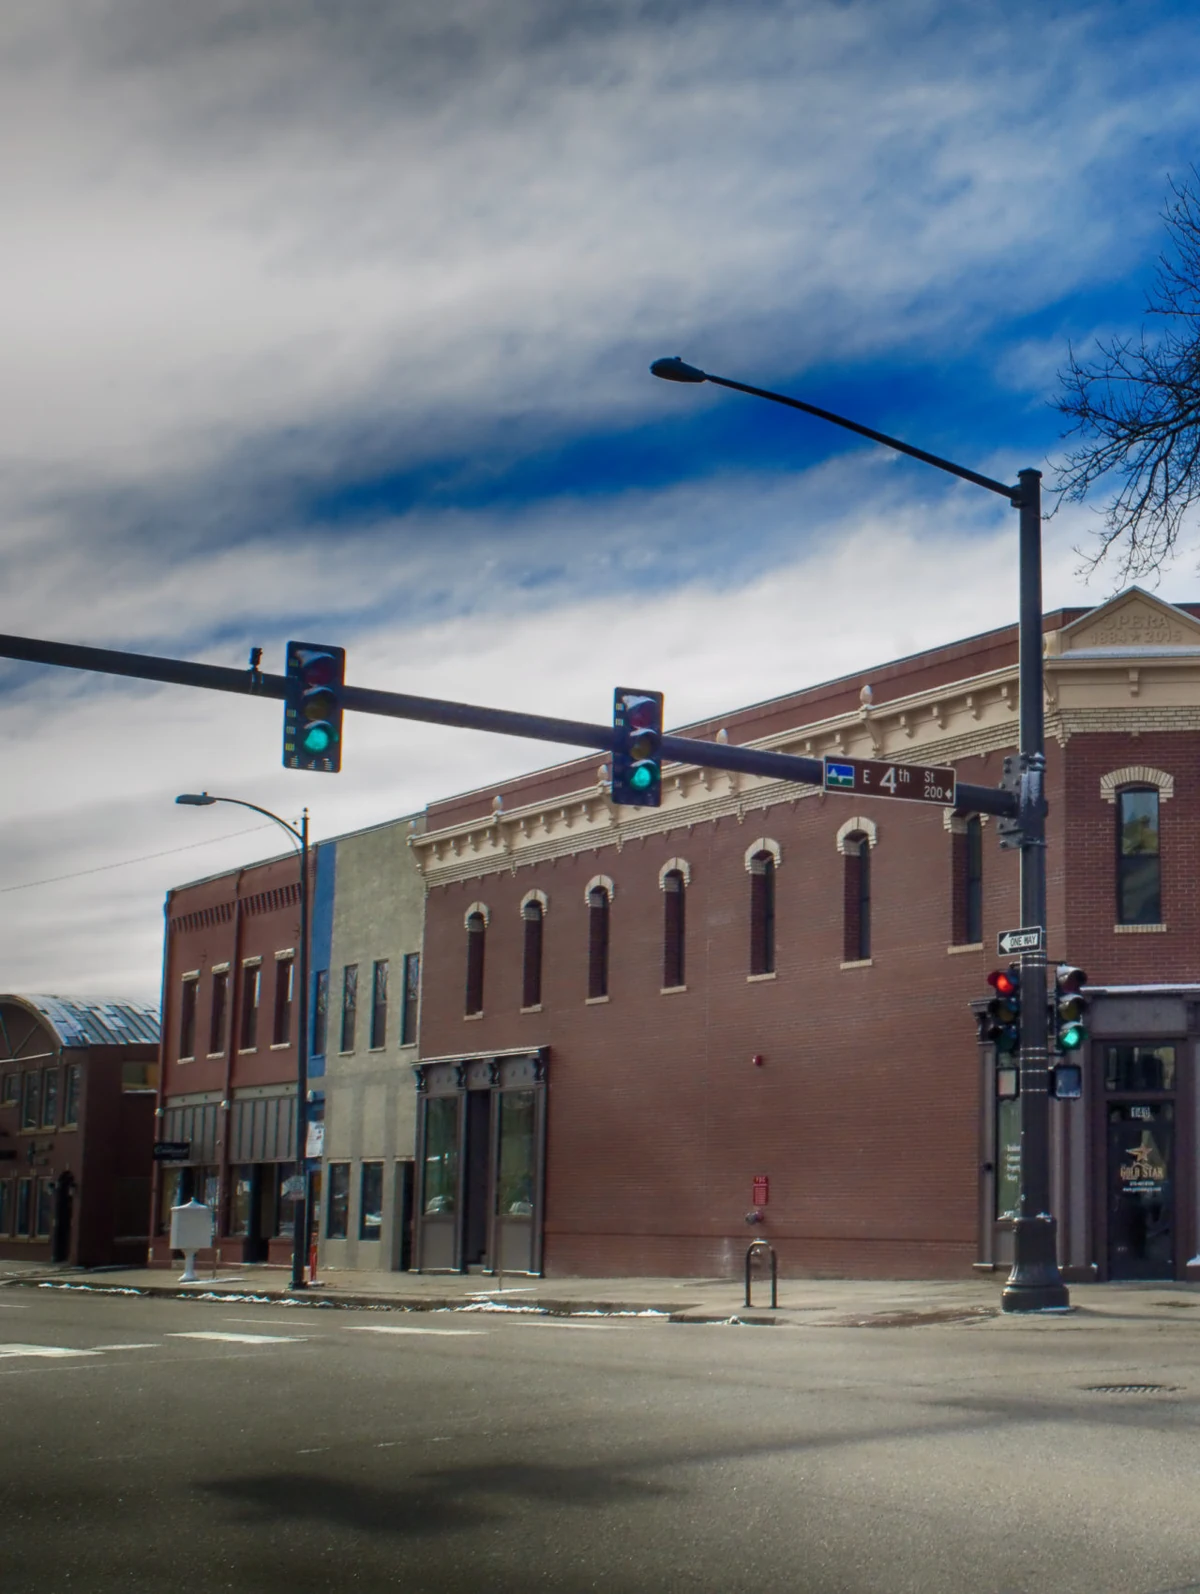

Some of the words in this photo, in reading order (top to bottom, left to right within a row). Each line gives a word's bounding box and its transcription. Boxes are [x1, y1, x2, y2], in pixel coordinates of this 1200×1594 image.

[1103, 615, 1170, 630] OPERA
[1091, 630, 1127, 645] 1884
[864, 770, 870, 783] E
[879, 767, 910, 794] 4th
[924, 770, 935, 783] St
[924, 786, 943, 799] 200
[1010, 936, 1022, 947] ONE
[1024, 935, 1036, 945] WAY
[1121, 1167, 1140, 1180] GOLD
[1143, 1167, 1164, 1180] STAR
